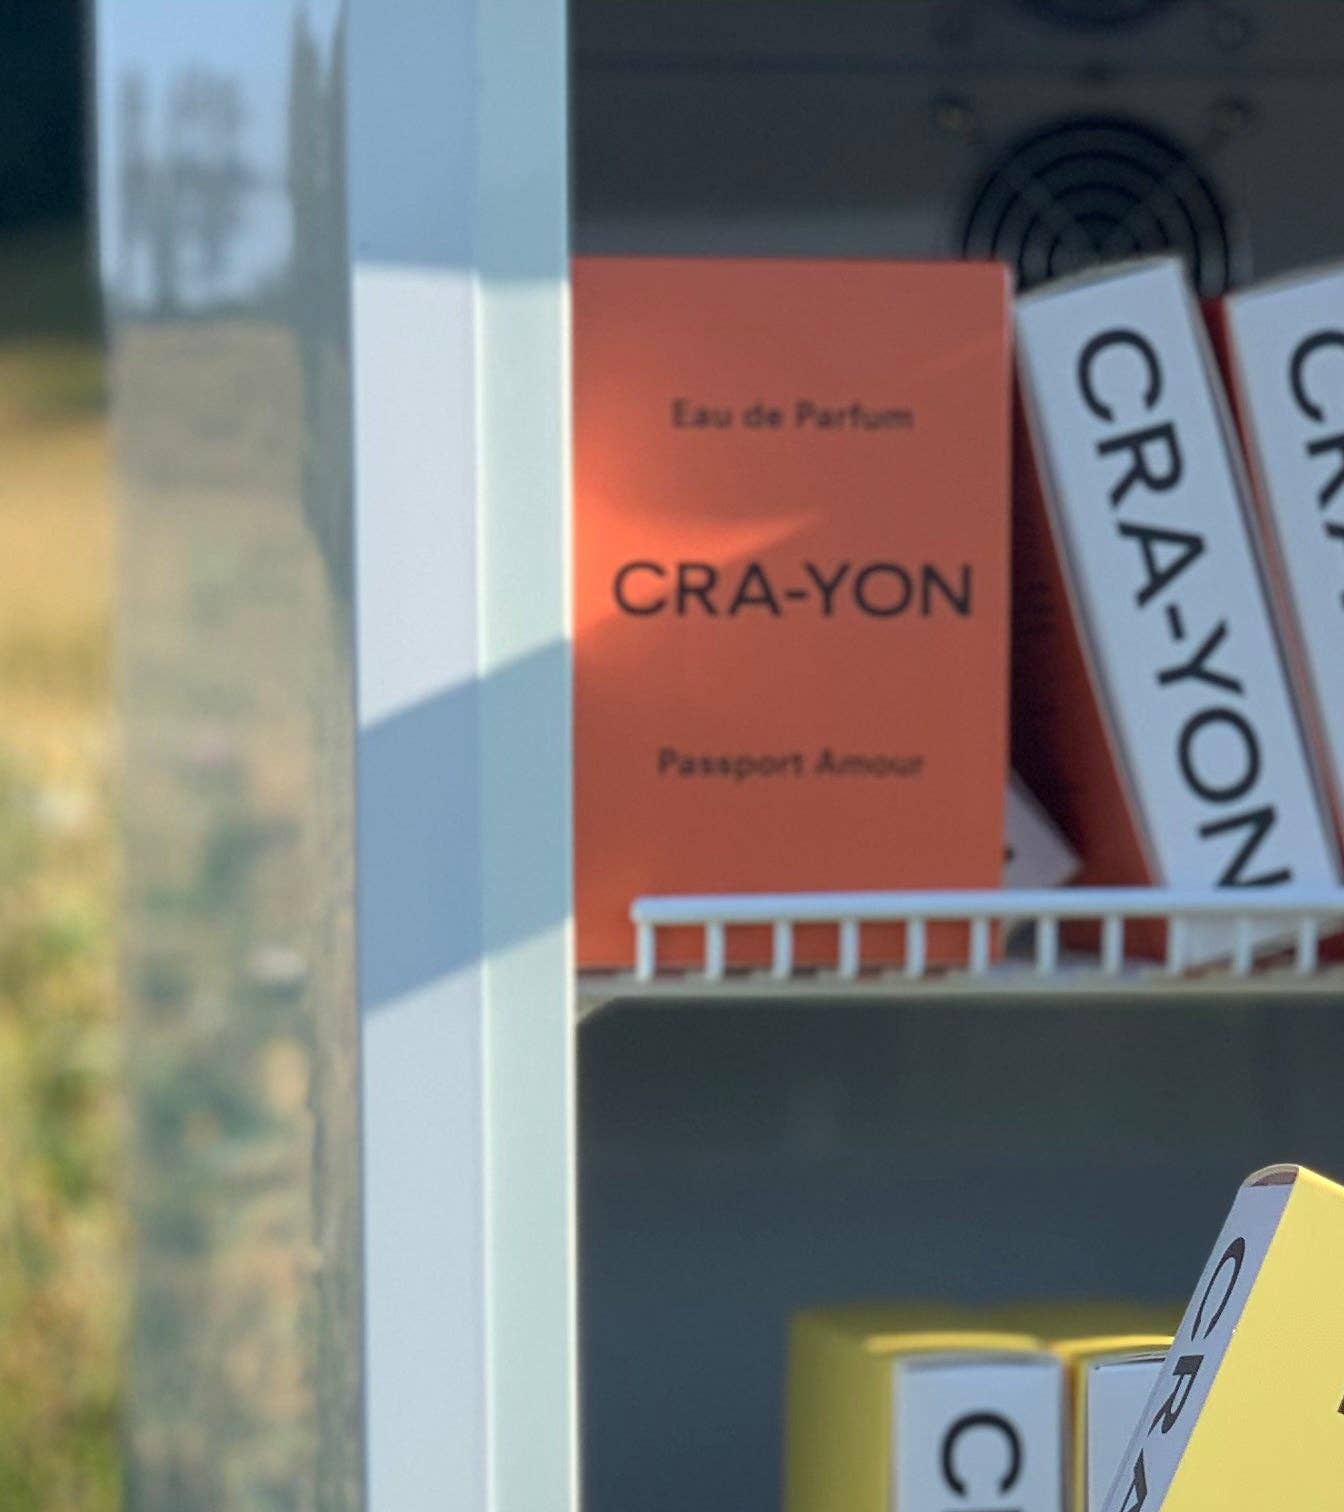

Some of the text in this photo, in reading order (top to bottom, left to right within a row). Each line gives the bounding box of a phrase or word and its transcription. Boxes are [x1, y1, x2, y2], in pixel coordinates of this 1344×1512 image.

[672, 399, 915, 431] Eau de Parfum
[612, 560, 973, 619] CRA-YON
[1076, 329, 1294, 886] CRA-YON
[659, 748, 925, 784] Passport Amour
